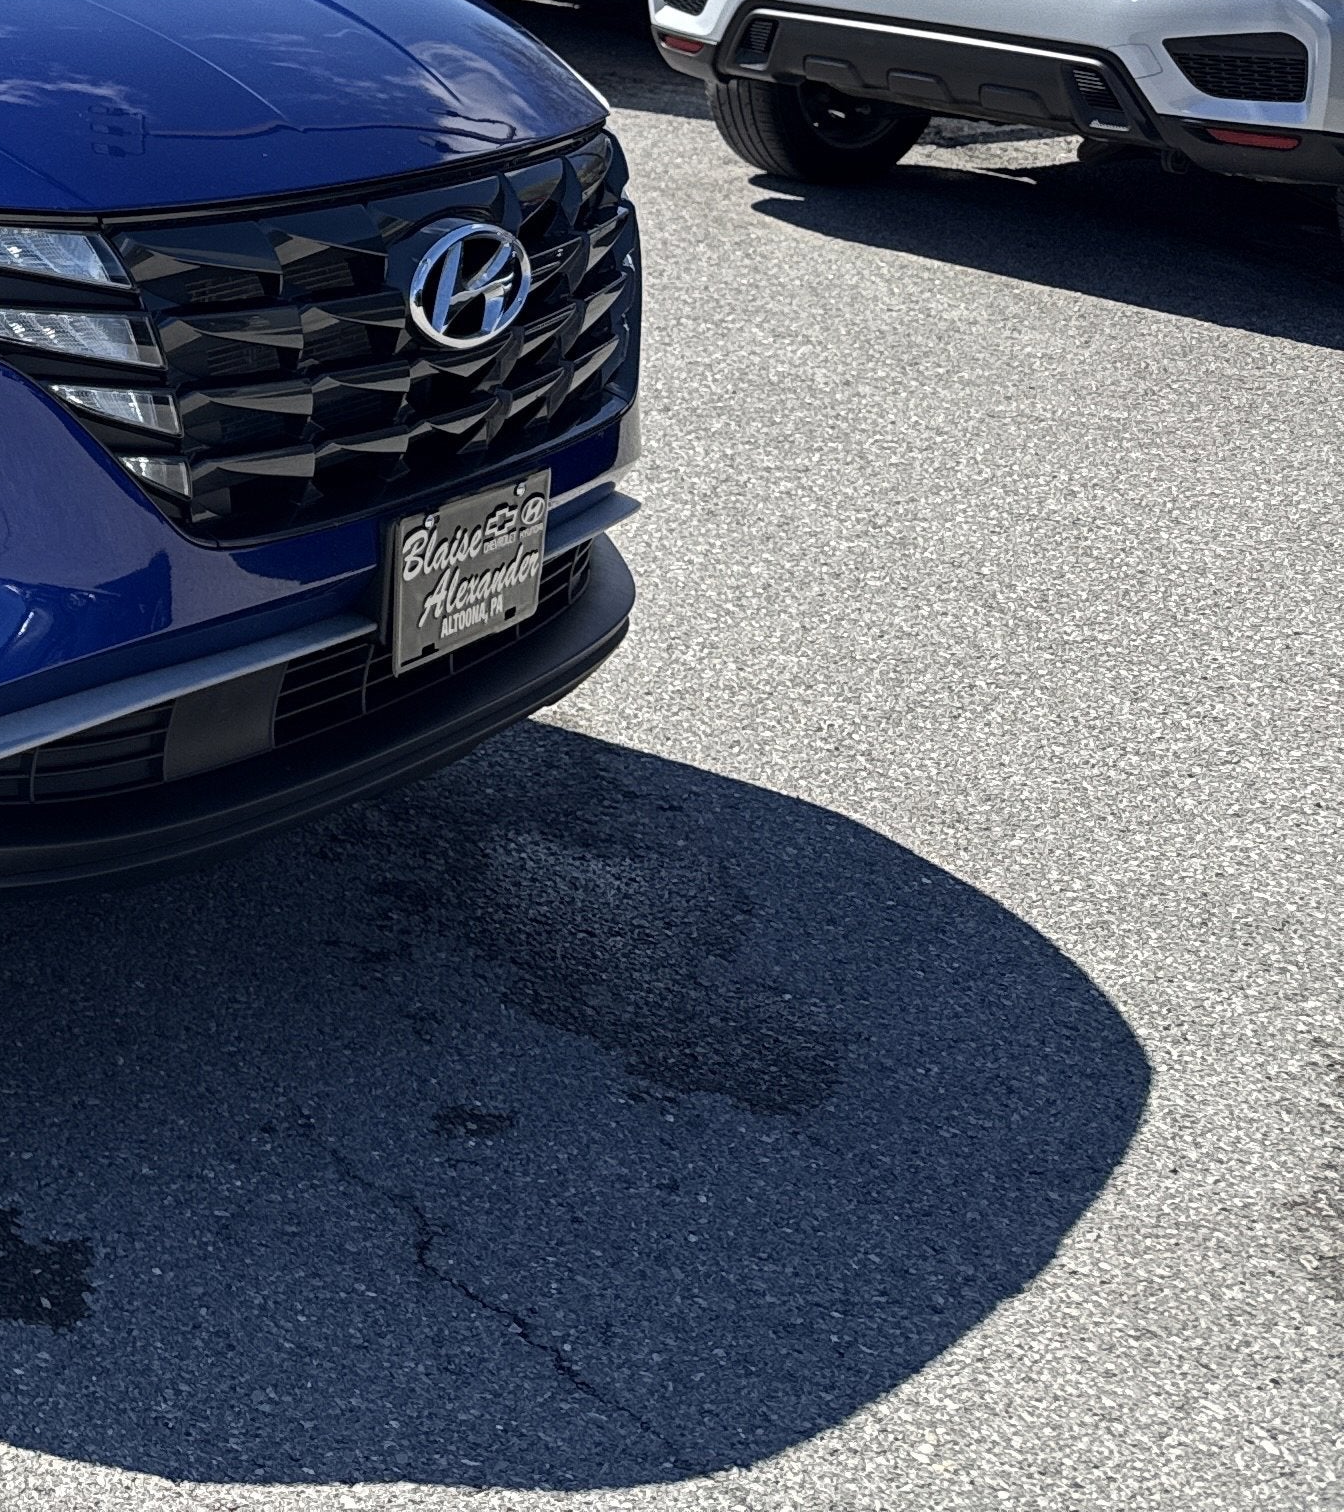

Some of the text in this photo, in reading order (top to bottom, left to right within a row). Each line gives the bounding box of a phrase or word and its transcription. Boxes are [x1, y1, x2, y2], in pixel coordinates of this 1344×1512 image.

[402, 524, 483, 582] Blaise
[418, 542, 540, 628] Alexander
[440, 594, 503, 639] ALTOONA, PA
